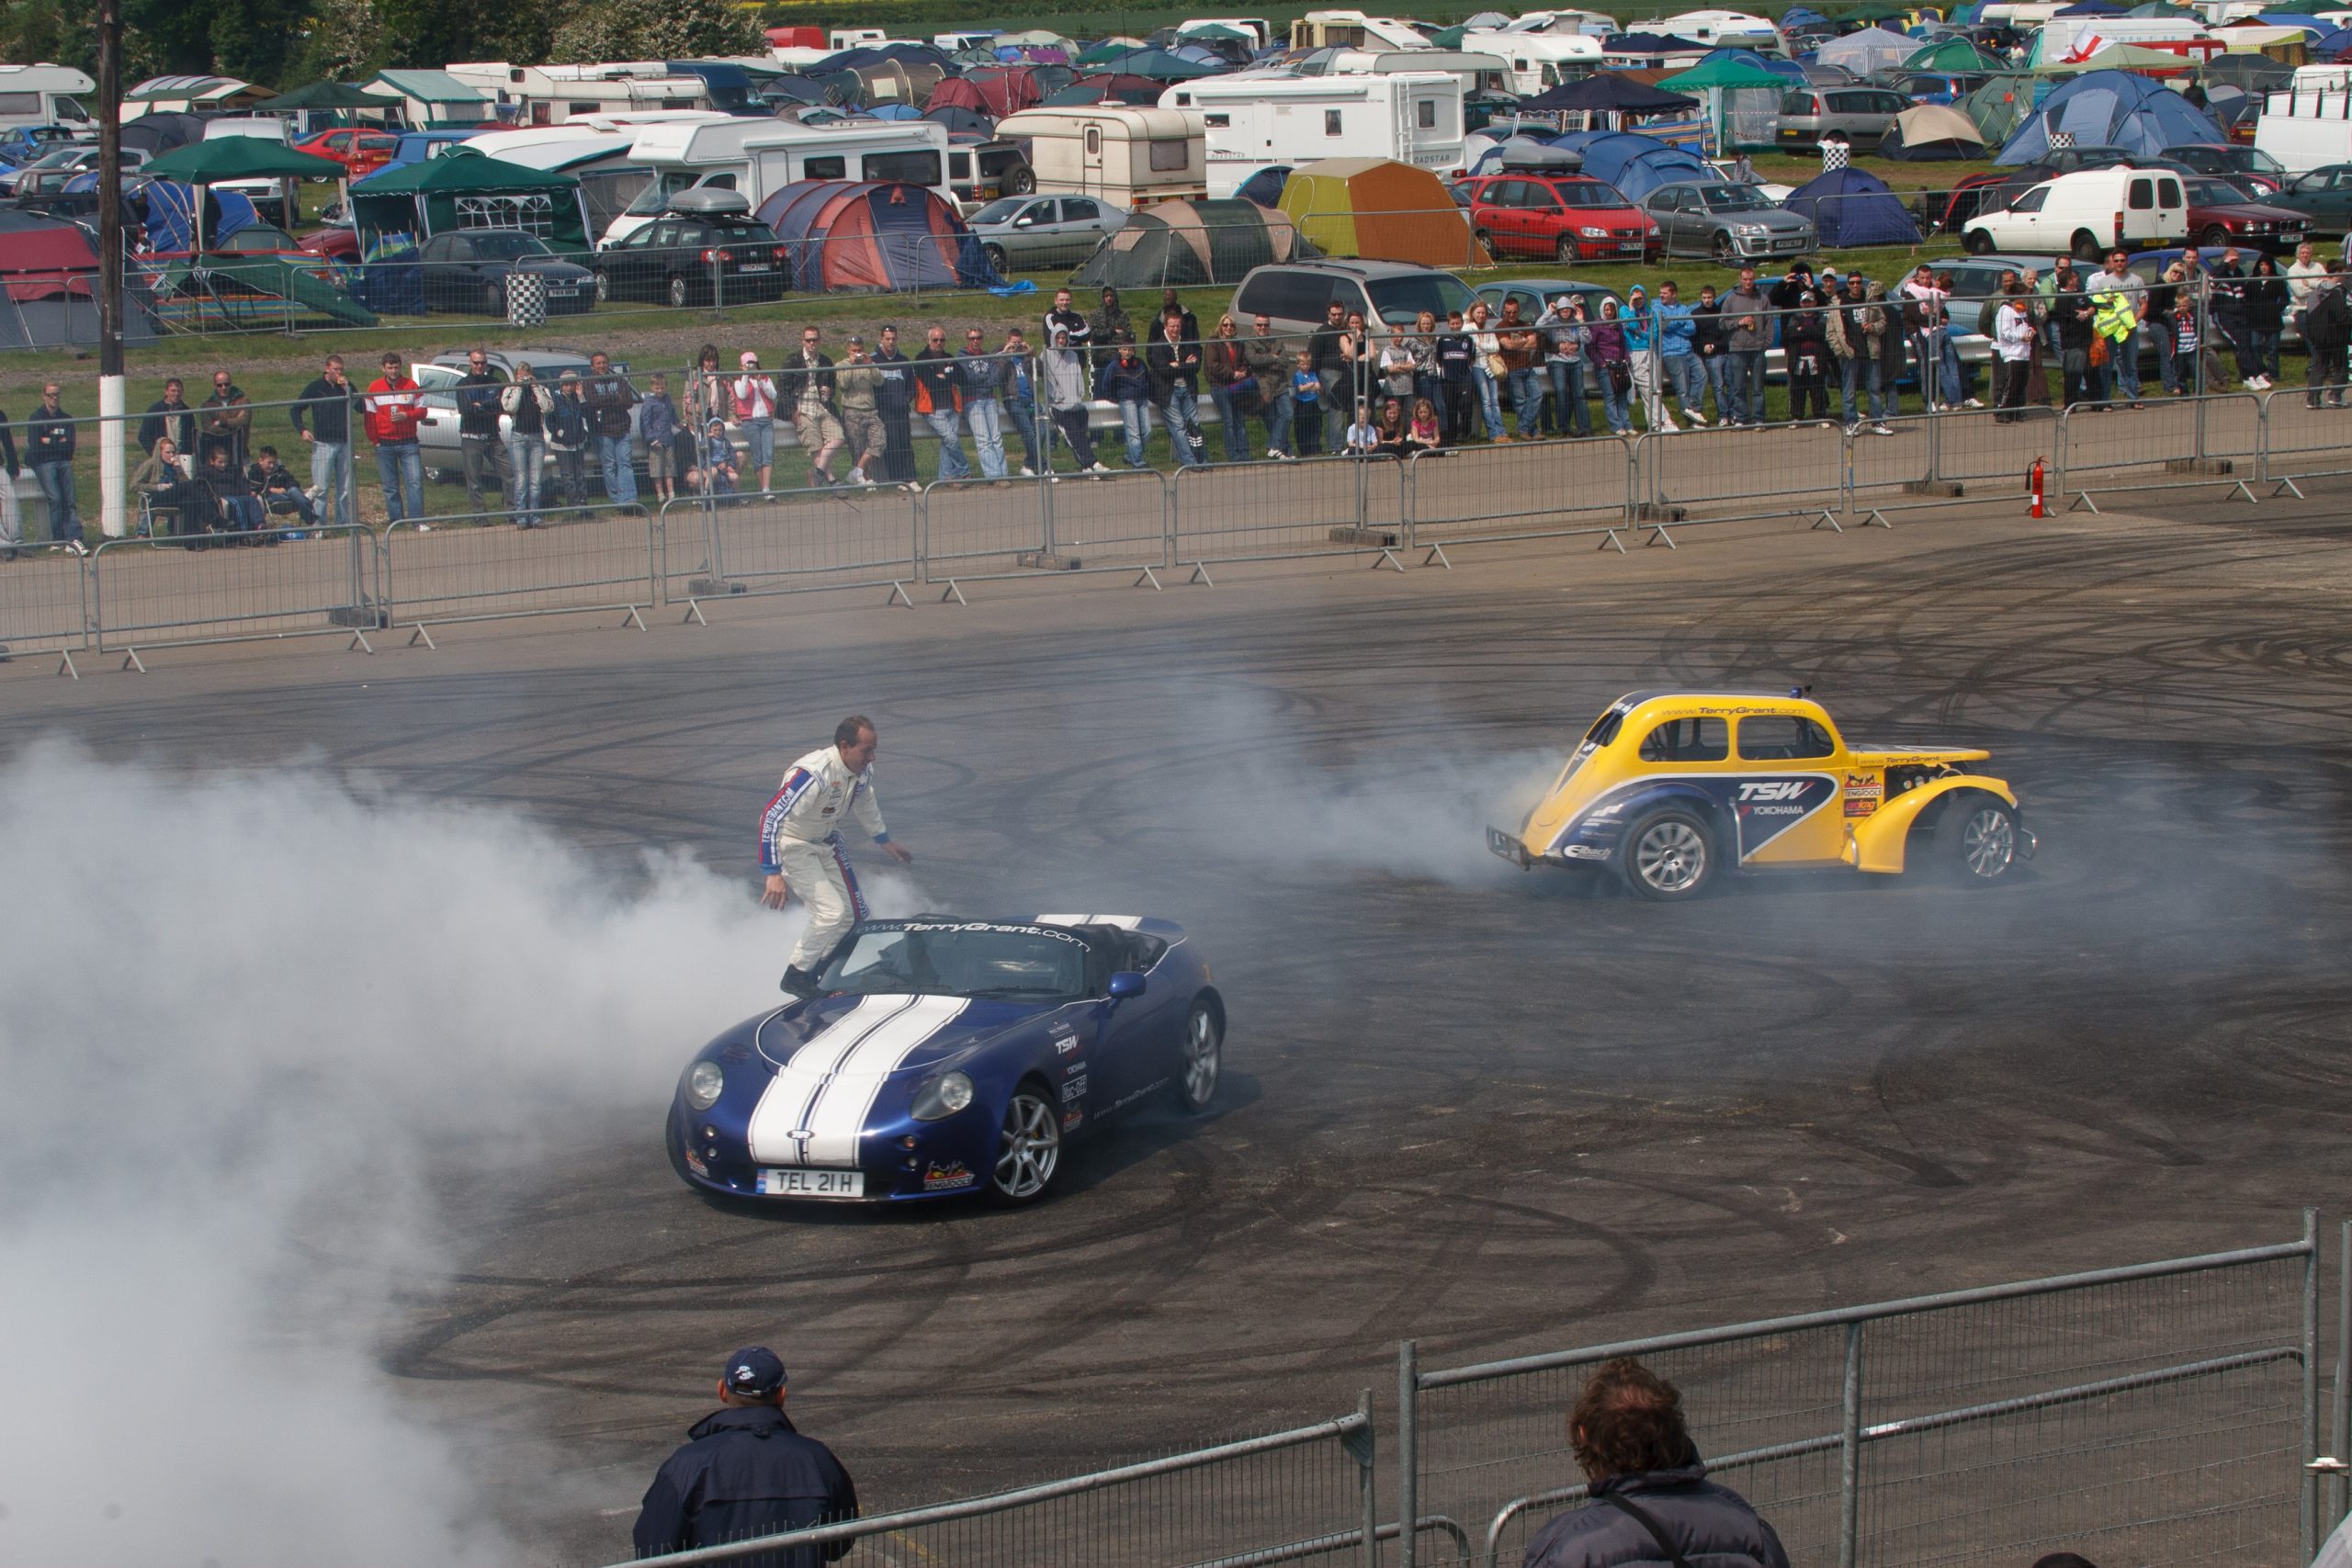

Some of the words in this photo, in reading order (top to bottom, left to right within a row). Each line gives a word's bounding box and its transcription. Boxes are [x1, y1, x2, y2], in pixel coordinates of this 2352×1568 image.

[1409, 154, 1450, 164] OADSTAR
[1662, 706, 1806, 716] www.TerryGrant.com
[1739, 782, 1814, 801] TSW
[1753, 805, 1804, 816] YOKOHAMA
[855, 922, 1091, 953] www.TerryGrant.com
[1055, 1034, 1080, 1055] TSW
[777, 1171, 811, 1191] TEL
[818, 1173, 834, 1191] 21
[841, 1174, 853, 1192] H
